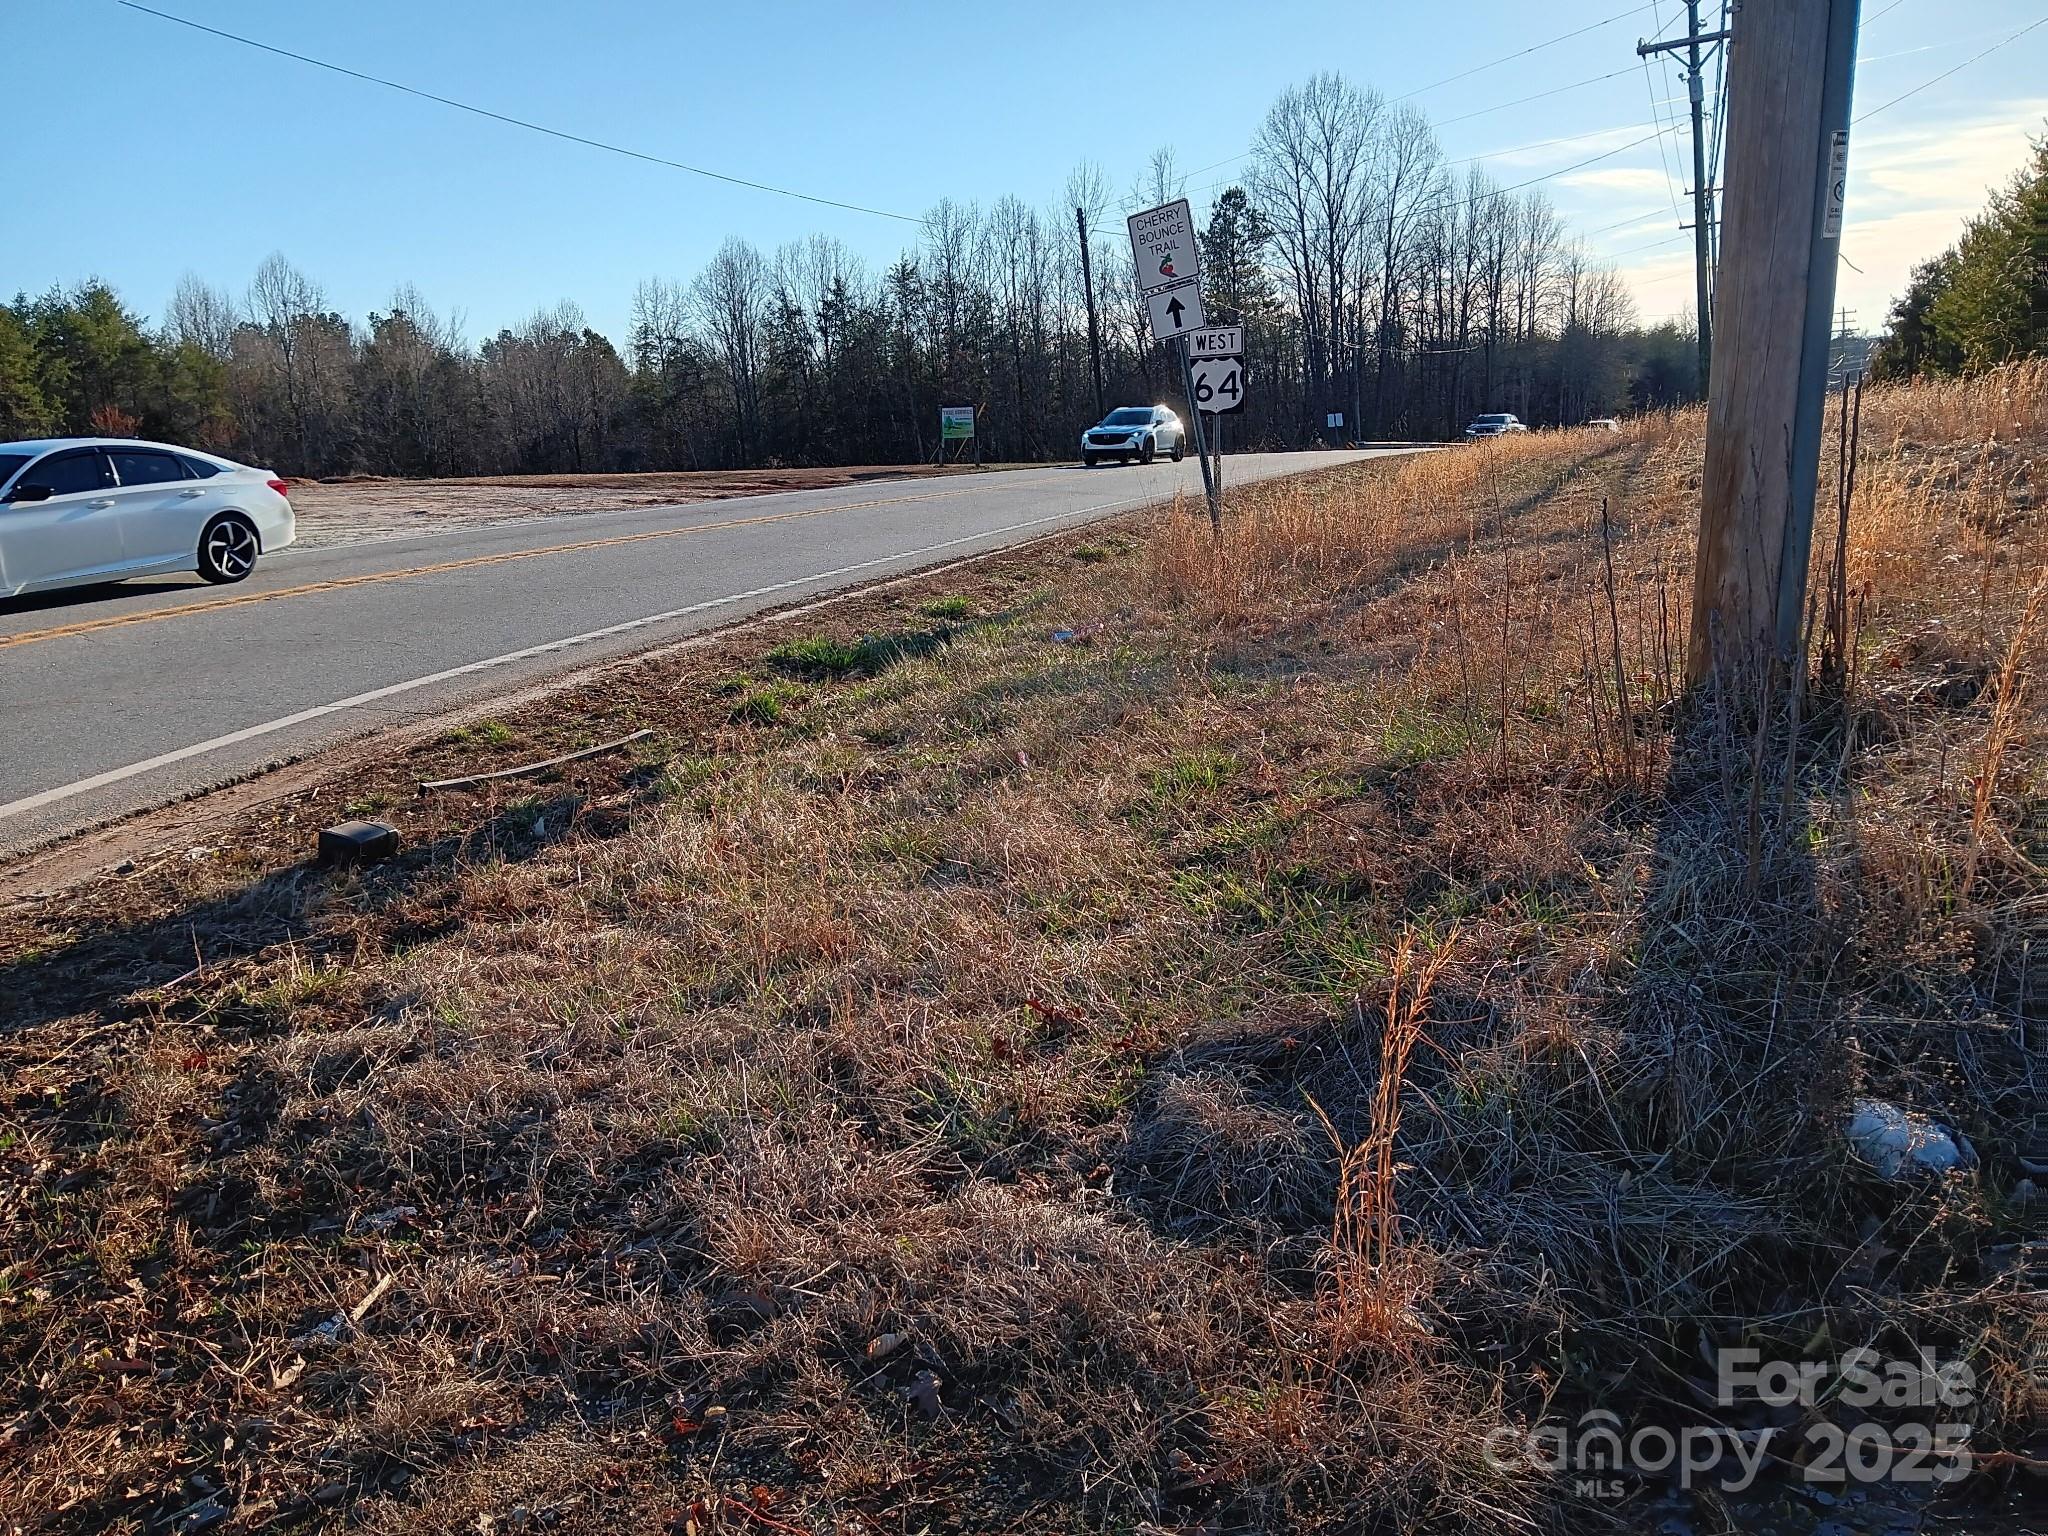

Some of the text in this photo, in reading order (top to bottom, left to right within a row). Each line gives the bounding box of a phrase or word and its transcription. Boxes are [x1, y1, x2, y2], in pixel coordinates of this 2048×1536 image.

[1137, 208, 1181, 231] CHERRY
[1139, 221, 1185, 246] BOUNCE
[1149, 239, 1180, 257] TRAIL
[1196, 332, 1236, 351] WEST
[1194, 370, 1240, 403] 64
